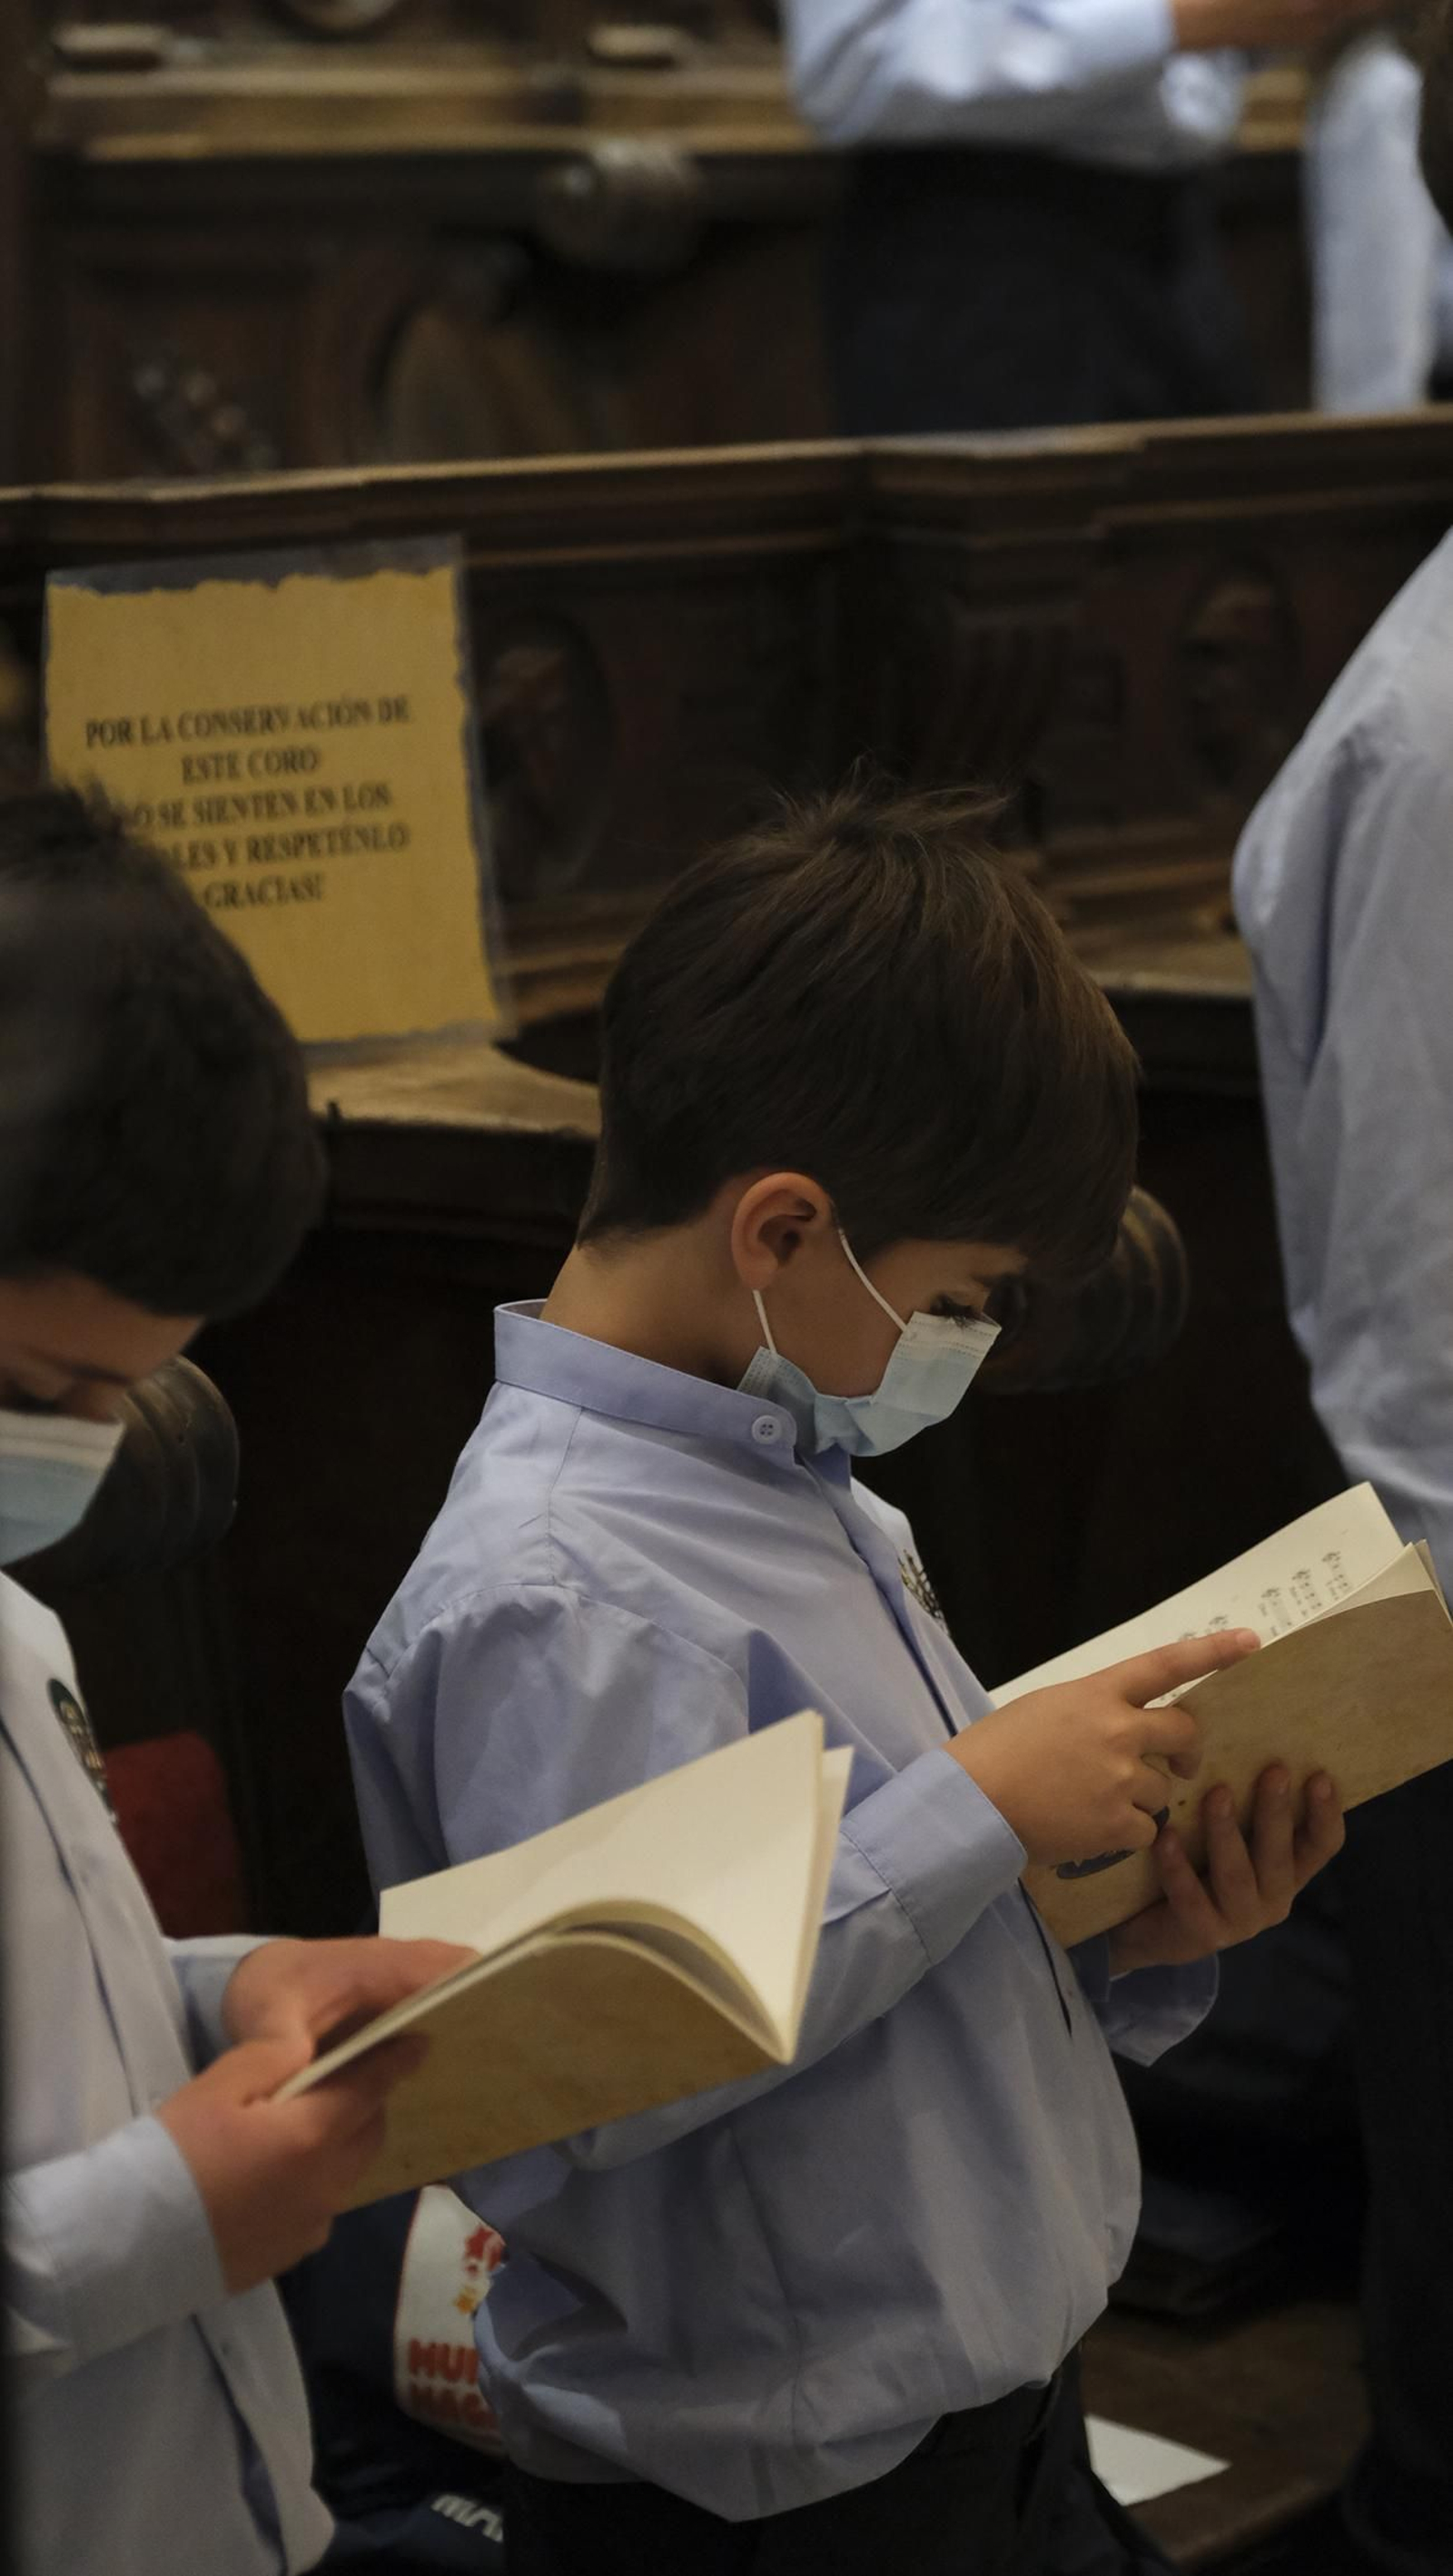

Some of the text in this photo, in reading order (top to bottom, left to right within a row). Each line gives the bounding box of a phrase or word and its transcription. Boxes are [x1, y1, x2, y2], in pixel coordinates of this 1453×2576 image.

[86, 718, 135, 748] POR
[140, 714, 173, 744] LA
[378, 695, 410, 723] DE
[183, 745, 321, 785] ESTE CORO
[159, 798, 187, 828] SE
[193, 788, 298, 824] SIENTEN
[303, 785, 338, 814] EN
[342, 781, 391, 810] LOS
